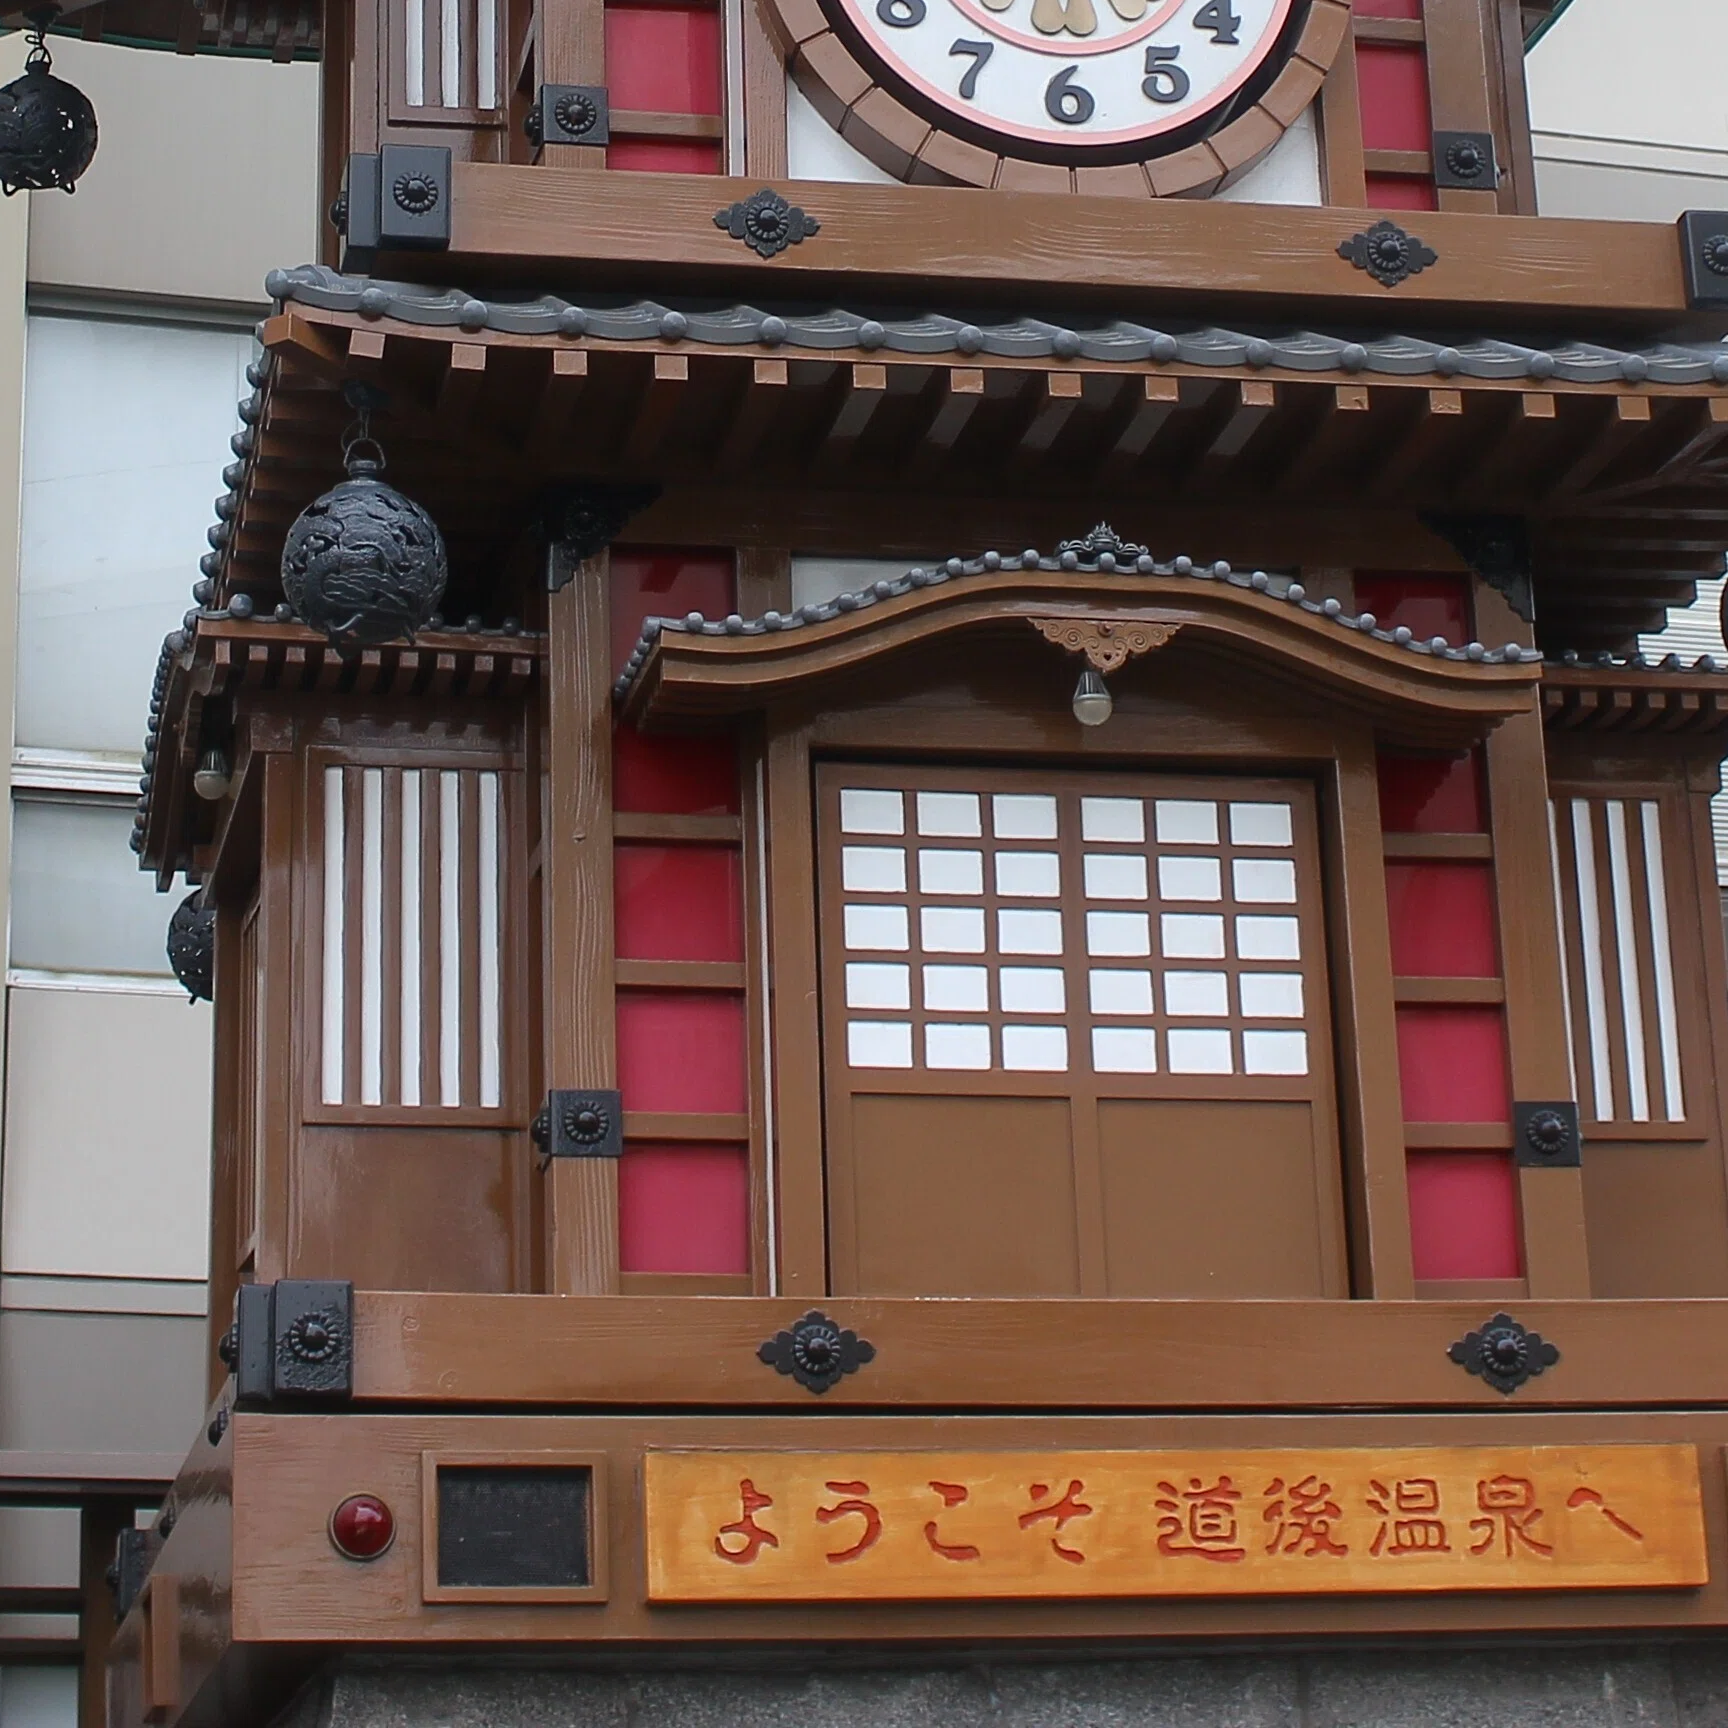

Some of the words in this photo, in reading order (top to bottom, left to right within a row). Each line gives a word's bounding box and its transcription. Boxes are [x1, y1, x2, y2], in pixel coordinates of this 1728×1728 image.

[949, 38, 994, 100] 7
[1044, 65, 1095, 126] 6
[1141, 45, 1190, 105] 5
[713, 1476, 1088, 1565] ようこそ
[1154, 1472, 1645, 1563] 道後温泉へ
